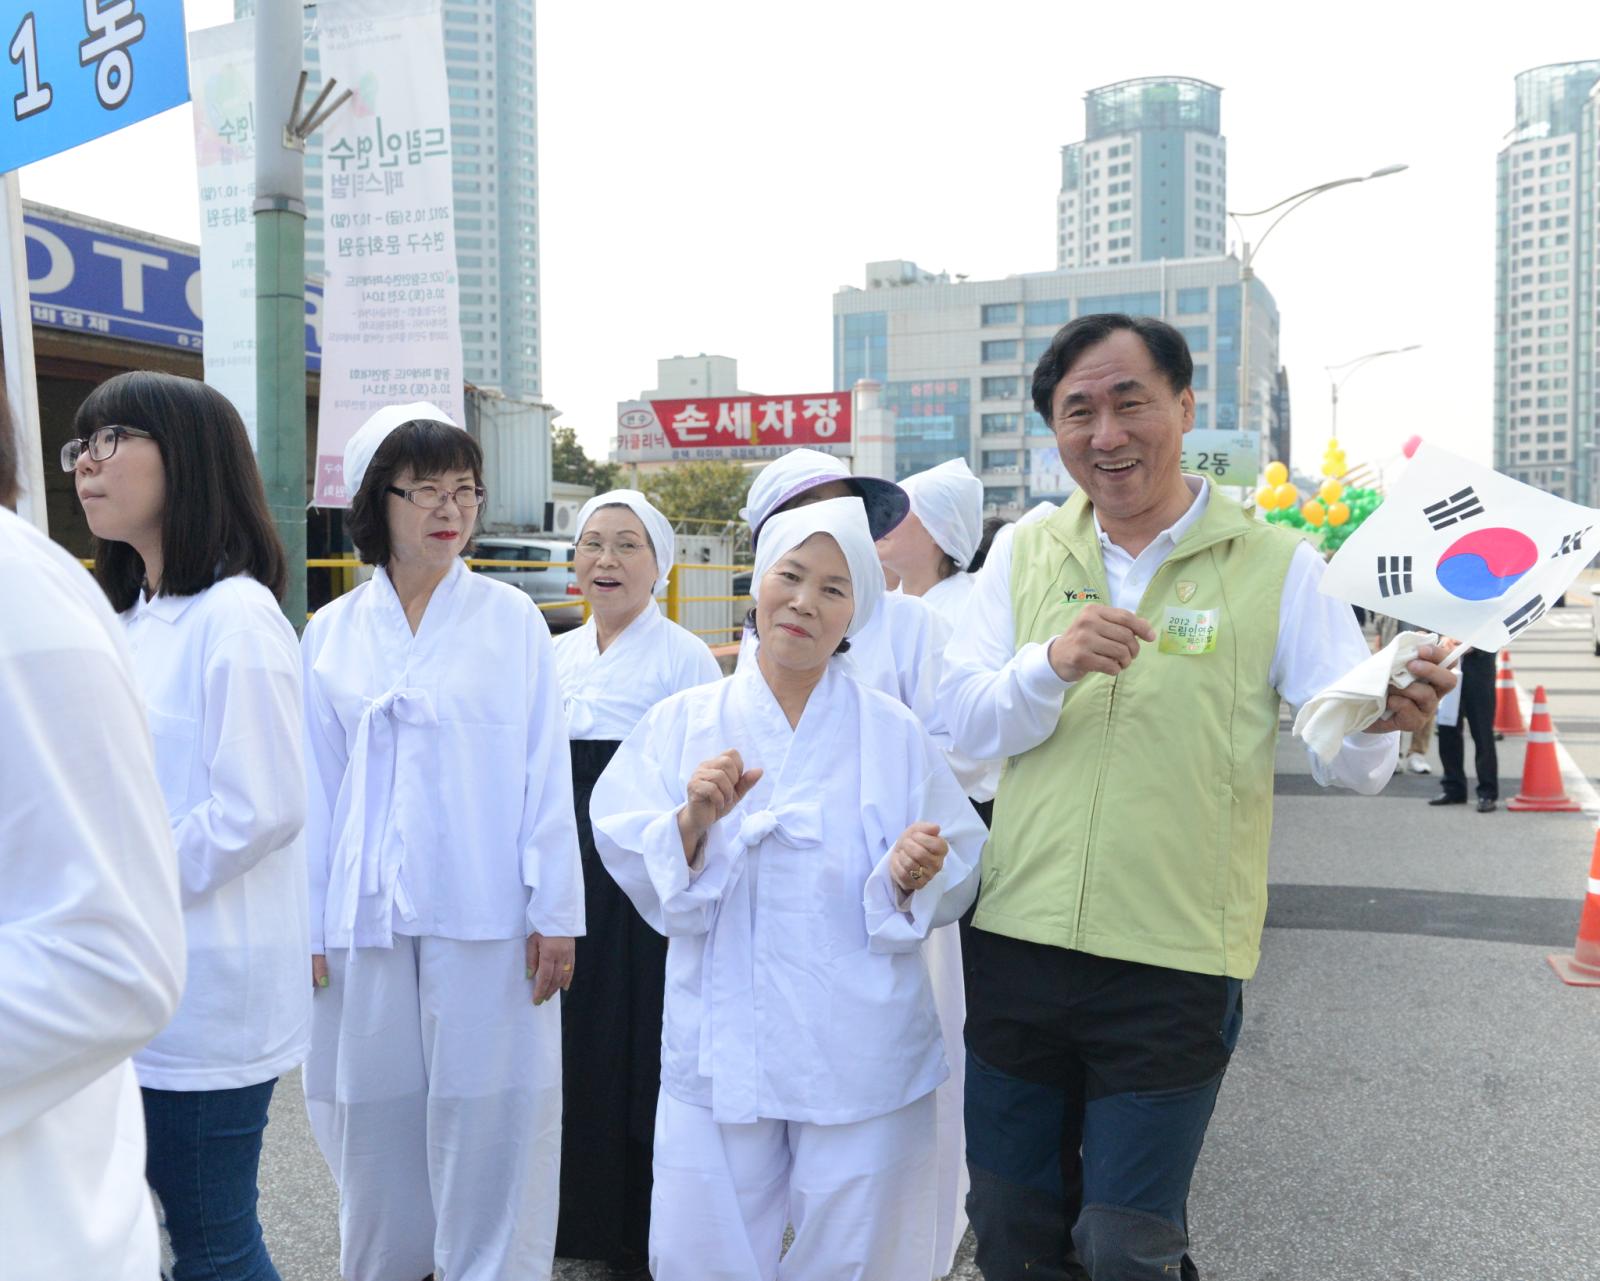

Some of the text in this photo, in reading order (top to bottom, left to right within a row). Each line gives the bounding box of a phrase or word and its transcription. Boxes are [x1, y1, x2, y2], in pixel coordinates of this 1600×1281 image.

[672, 399, 842, 442] 손세차장
[617, 431, 665, 450] 카클리닉
[1169, 616, 1190, 626] 2012
